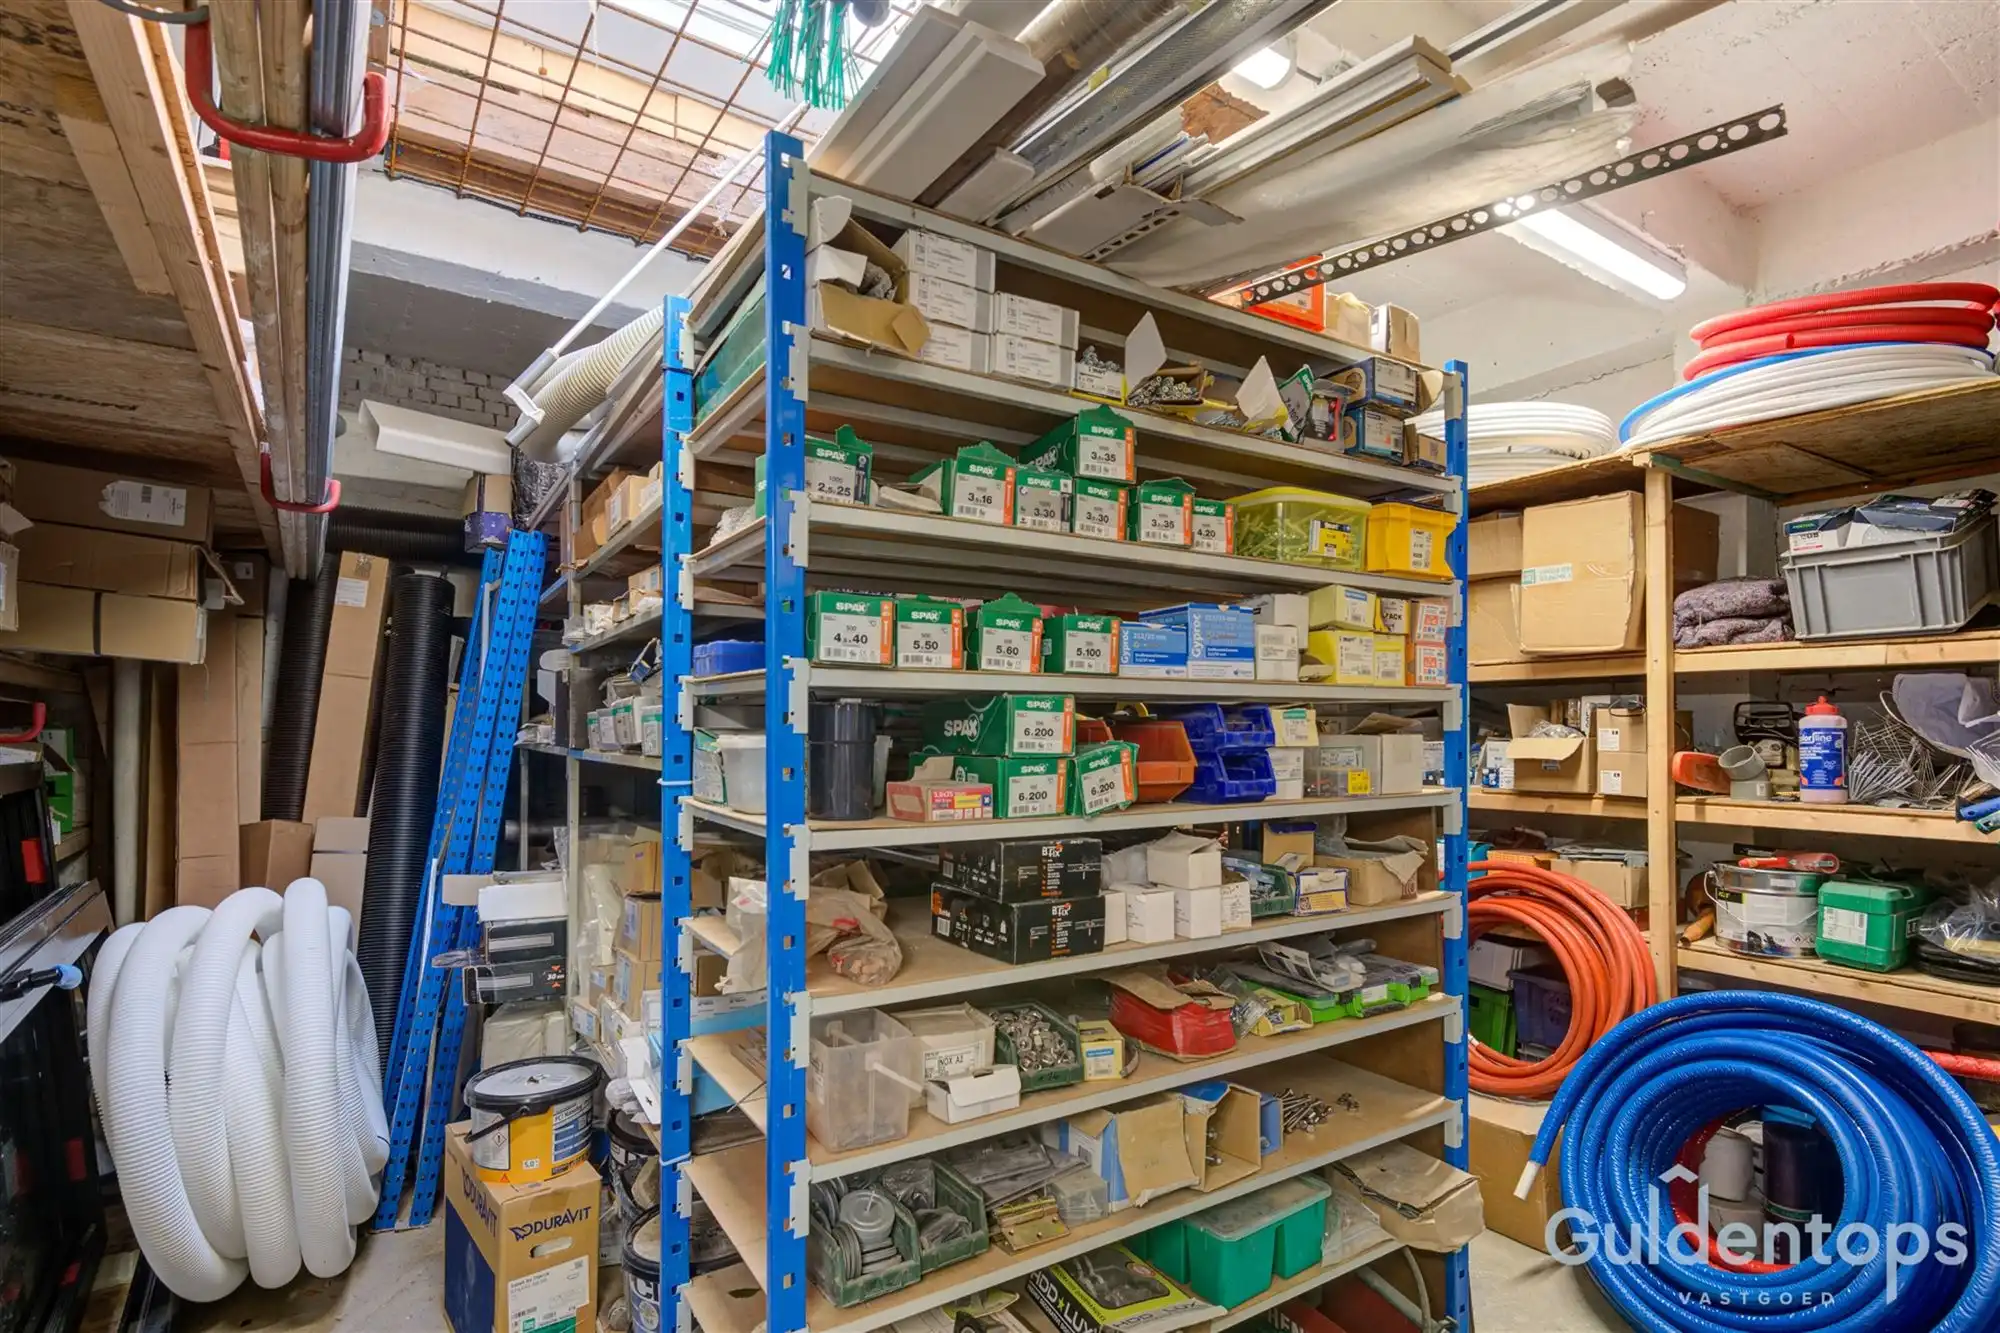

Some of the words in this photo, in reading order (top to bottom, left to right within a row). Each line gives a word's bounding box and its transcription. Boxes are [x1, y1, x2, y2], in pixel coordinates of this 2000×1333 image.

[1091, 425, 1115, 436] SPAX
[816, 447, 846, 462] SPAX
[969, 464, 996, 476] SPAX
[1027, 477, 1053, 488] SPAX
[1087, 486, 1111, 498] SPAX
[1151, 494, 1174, 504] SPAX
[835, 601, 867, 612] SPAX
[911, 610, 939, 621] SPAX
[995, 618, 1021, 629] SPAX
[1077, 620, 1102, 630] SPAX
[1191, 613, 1204, 658] Gyproc
[1120, 629, 1132, 664] Gyproc
[1026, 700, 1053, 710] SPAX
[944, 714, 979, 743] SPAX
[1020, 764, 1047, 773] SPAX
[1089, 758, 1110, 769] SPAX
[532, 1206, 592, 1236] DURAVIT
